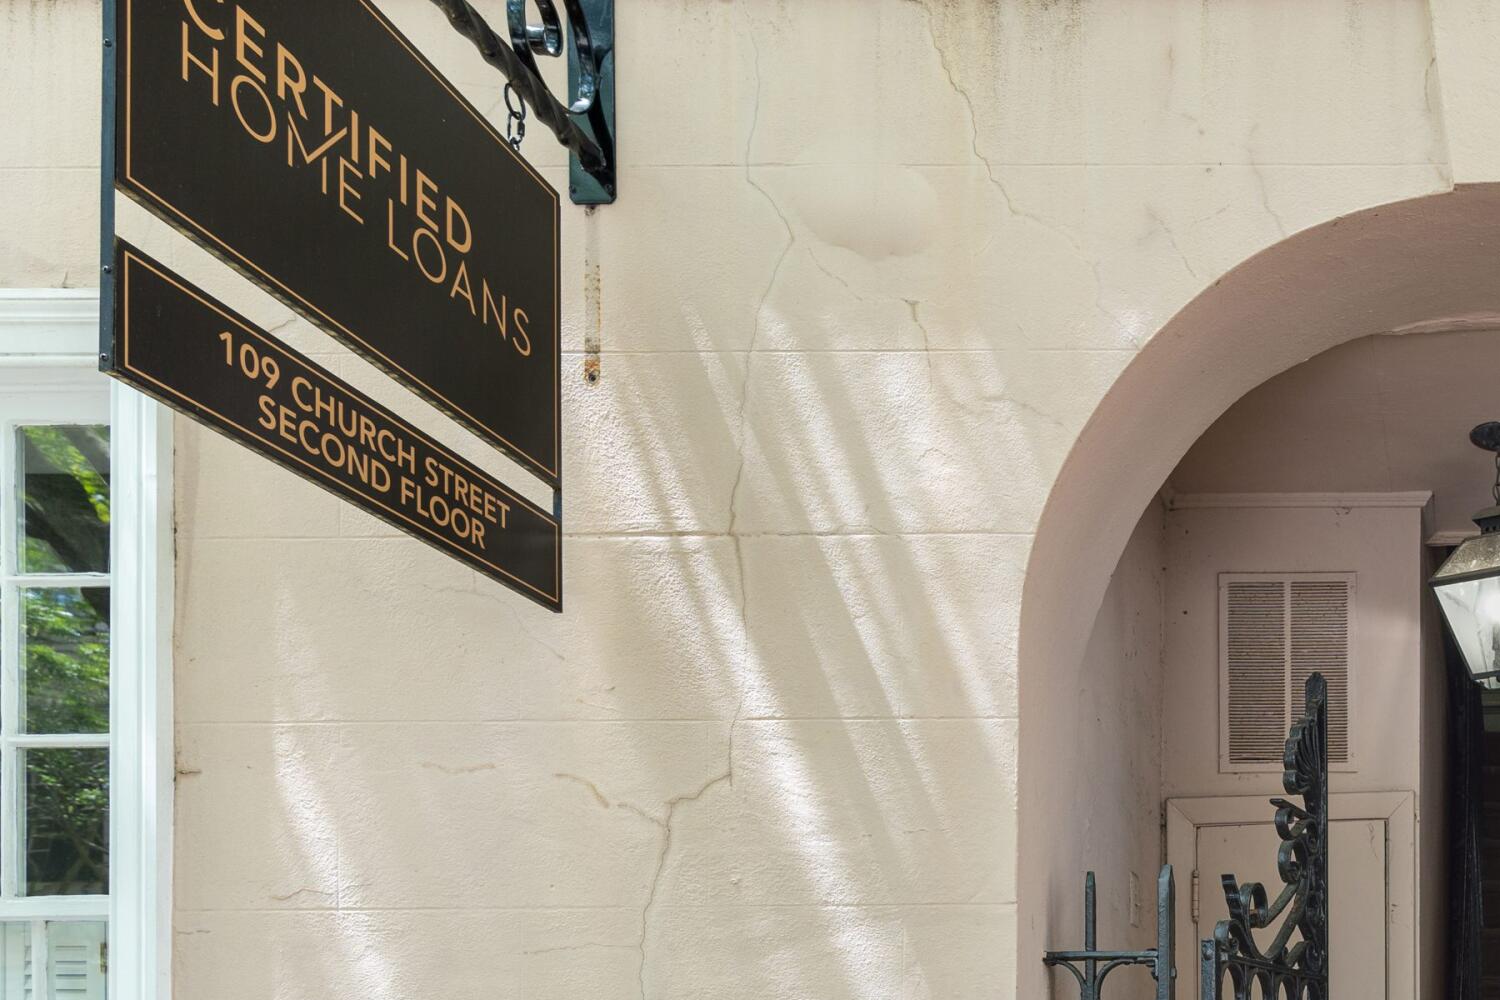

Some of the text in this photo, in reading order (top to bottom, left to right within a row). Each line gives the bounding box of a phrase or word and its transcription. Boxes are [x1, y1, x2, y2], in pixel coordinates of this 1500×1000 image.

[182, 22, 530, 356] HOME LOANS
[184, 0, 472, 253] CERTIFIED
[219, 332, 510, 528] 109 CHURCH STREET
[258, 395, 485, 549] SECOND FLOOR
